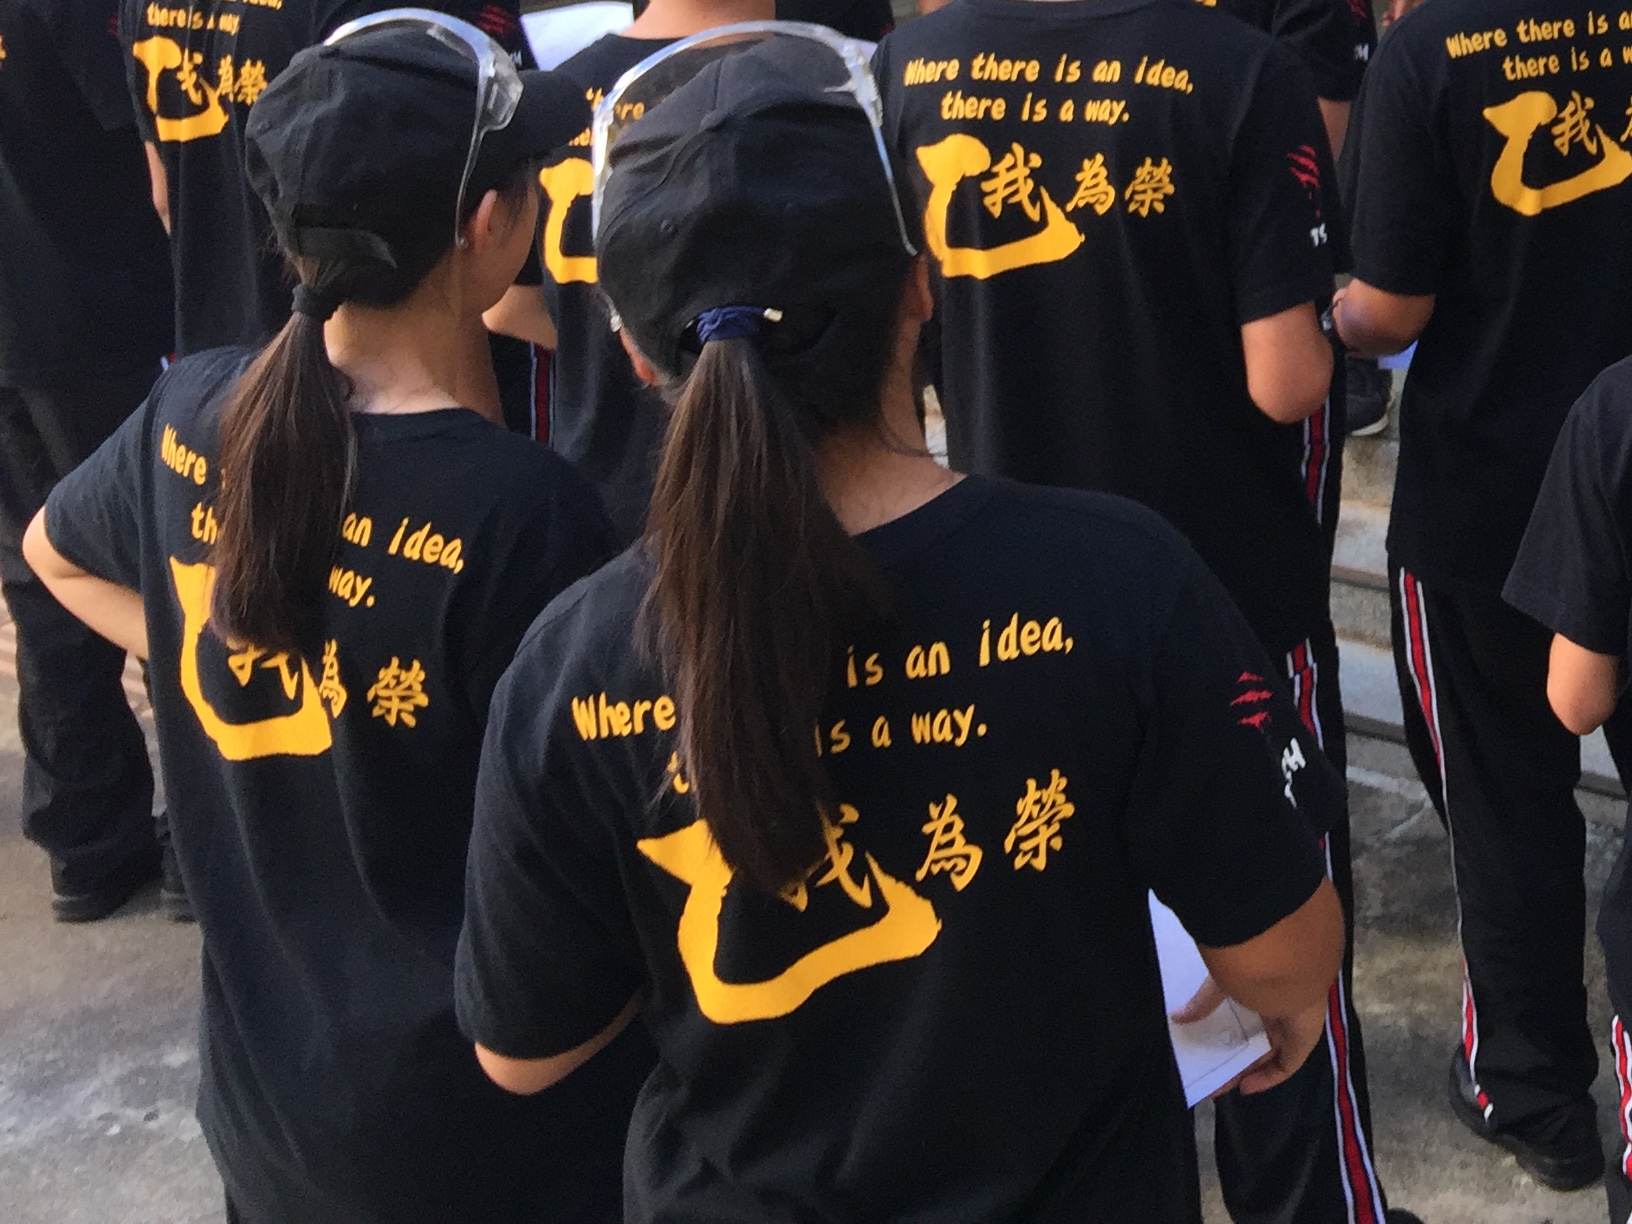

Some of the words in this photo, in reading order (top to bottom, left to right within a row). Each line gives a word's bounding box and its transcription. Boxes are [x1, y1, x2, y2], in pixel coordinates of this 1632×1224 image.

[1445, 30, 1507, 59] Where
[1516, 17, 1575, 43] there
[1588, 11, 1609, 36] is
[903, 57, 960, 87] Where
[971, 52, 1040, 83] there
[1054, 53, 1081, 84] is
[1092, 59, 1122, 83] an
[1134, 55, 1194, 95] idea,
[1502, 54, 1560, 82] there
[1571, 47, 1590, 72] is
[1599, 47, 1613, 69] a
[940, 91, 1006, 122] there
[1020, 92, 1048, 123] is
[1058, 98, 1075, 123] a
[1084, 98, 1130, 127] way.
[161, 424, 208, 486] Where
[342, 512, 373, 548] an
[388, 516, 466, 575] idea,
[571, 695, 677, 743] Where
[847, 642, 884, 688] is
[905, 640, 951, 681] an
[979, 612, 1076, 667] idea,
[871, 716, 893, 750] a
[910, 702, 989, 746] way.
